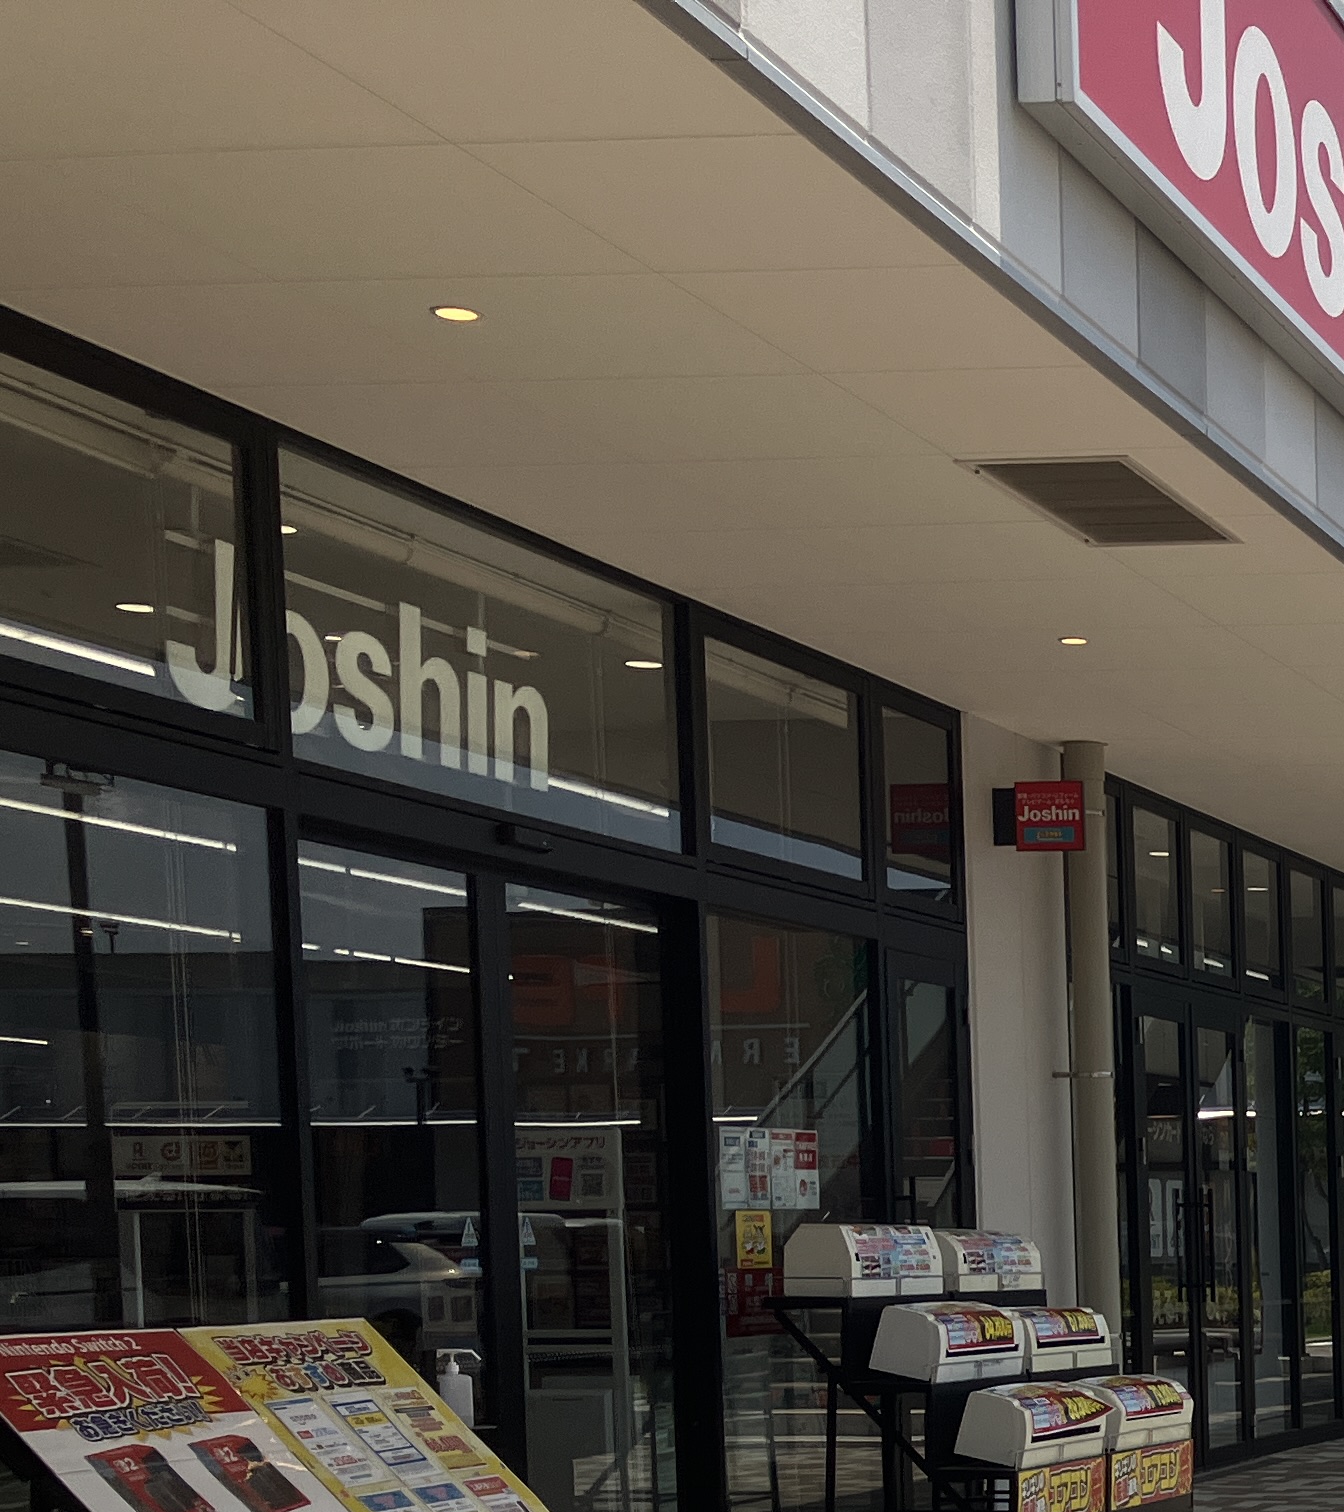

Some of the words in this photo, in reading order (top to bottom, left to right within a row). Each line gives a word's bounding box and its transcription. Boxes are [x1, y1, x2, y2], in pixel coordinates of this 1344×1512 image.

[1017, 805, 1080, 822] Joshin
[0, 1339, 75, 1357] Nintendo
[73, 1336, 127, 1354] Switch
[126, 1336, 141, 1350] 2
[213, 1330, 372, 1364] 当店キャンペーン
[265, 1358, 385, 1391] おすすめ商品
[1141, 1452, 1179, 1495] エアコン
